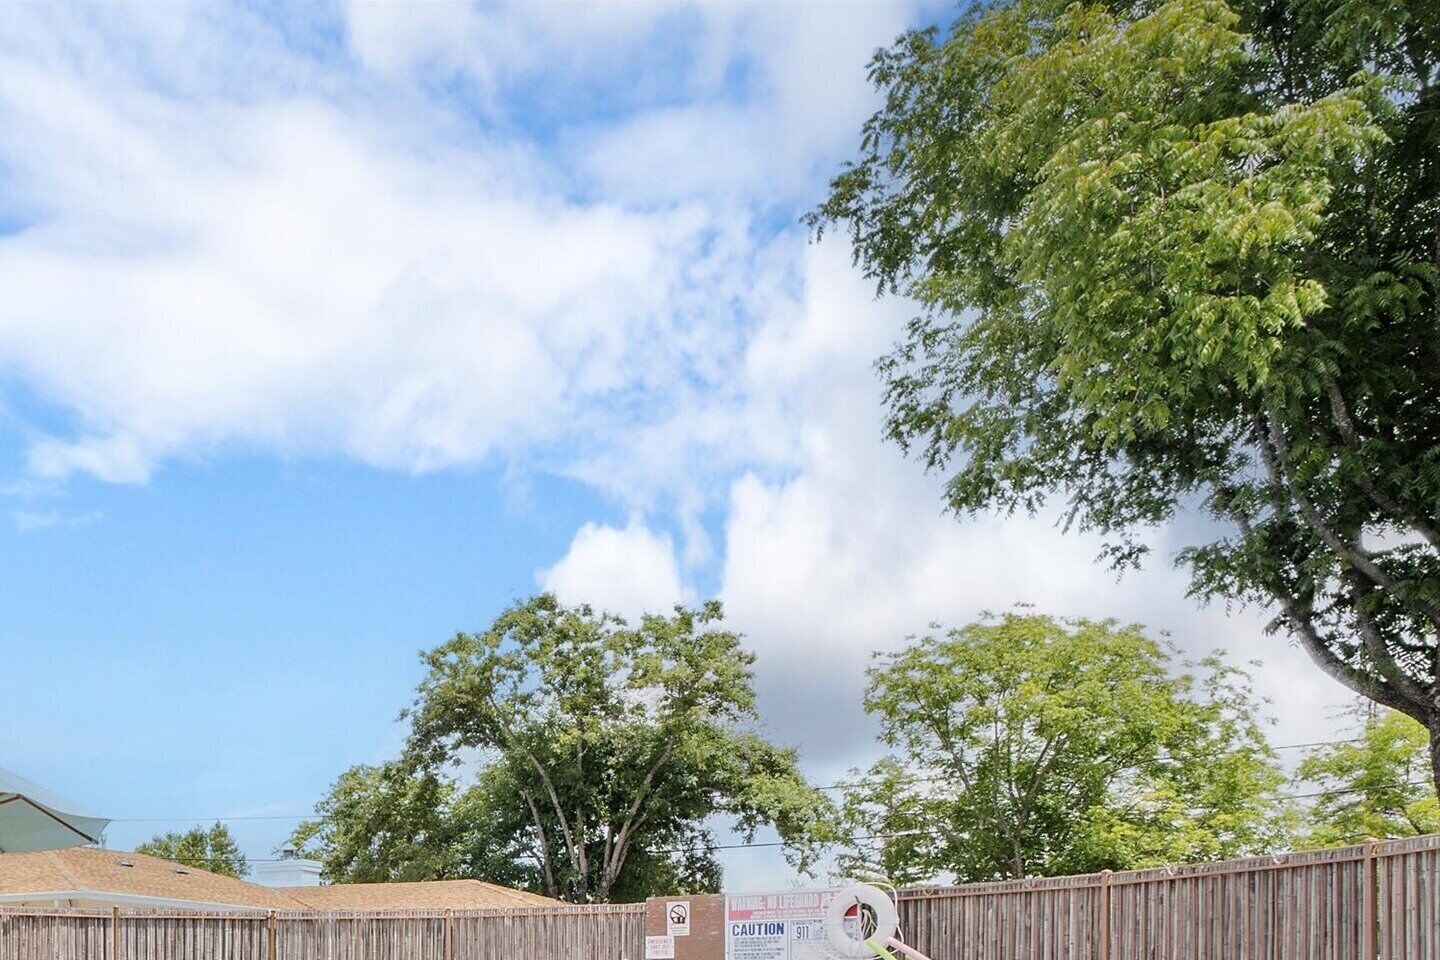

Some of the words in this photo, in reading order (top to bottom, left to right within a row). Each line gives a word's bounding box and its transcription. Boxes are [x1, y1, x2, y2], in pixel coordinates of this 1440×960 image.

[780, 893, 820, 909] LIFEGUARD
[732, 923, 785, 936] CAUTION
[796, 926, 809, 938] 911
